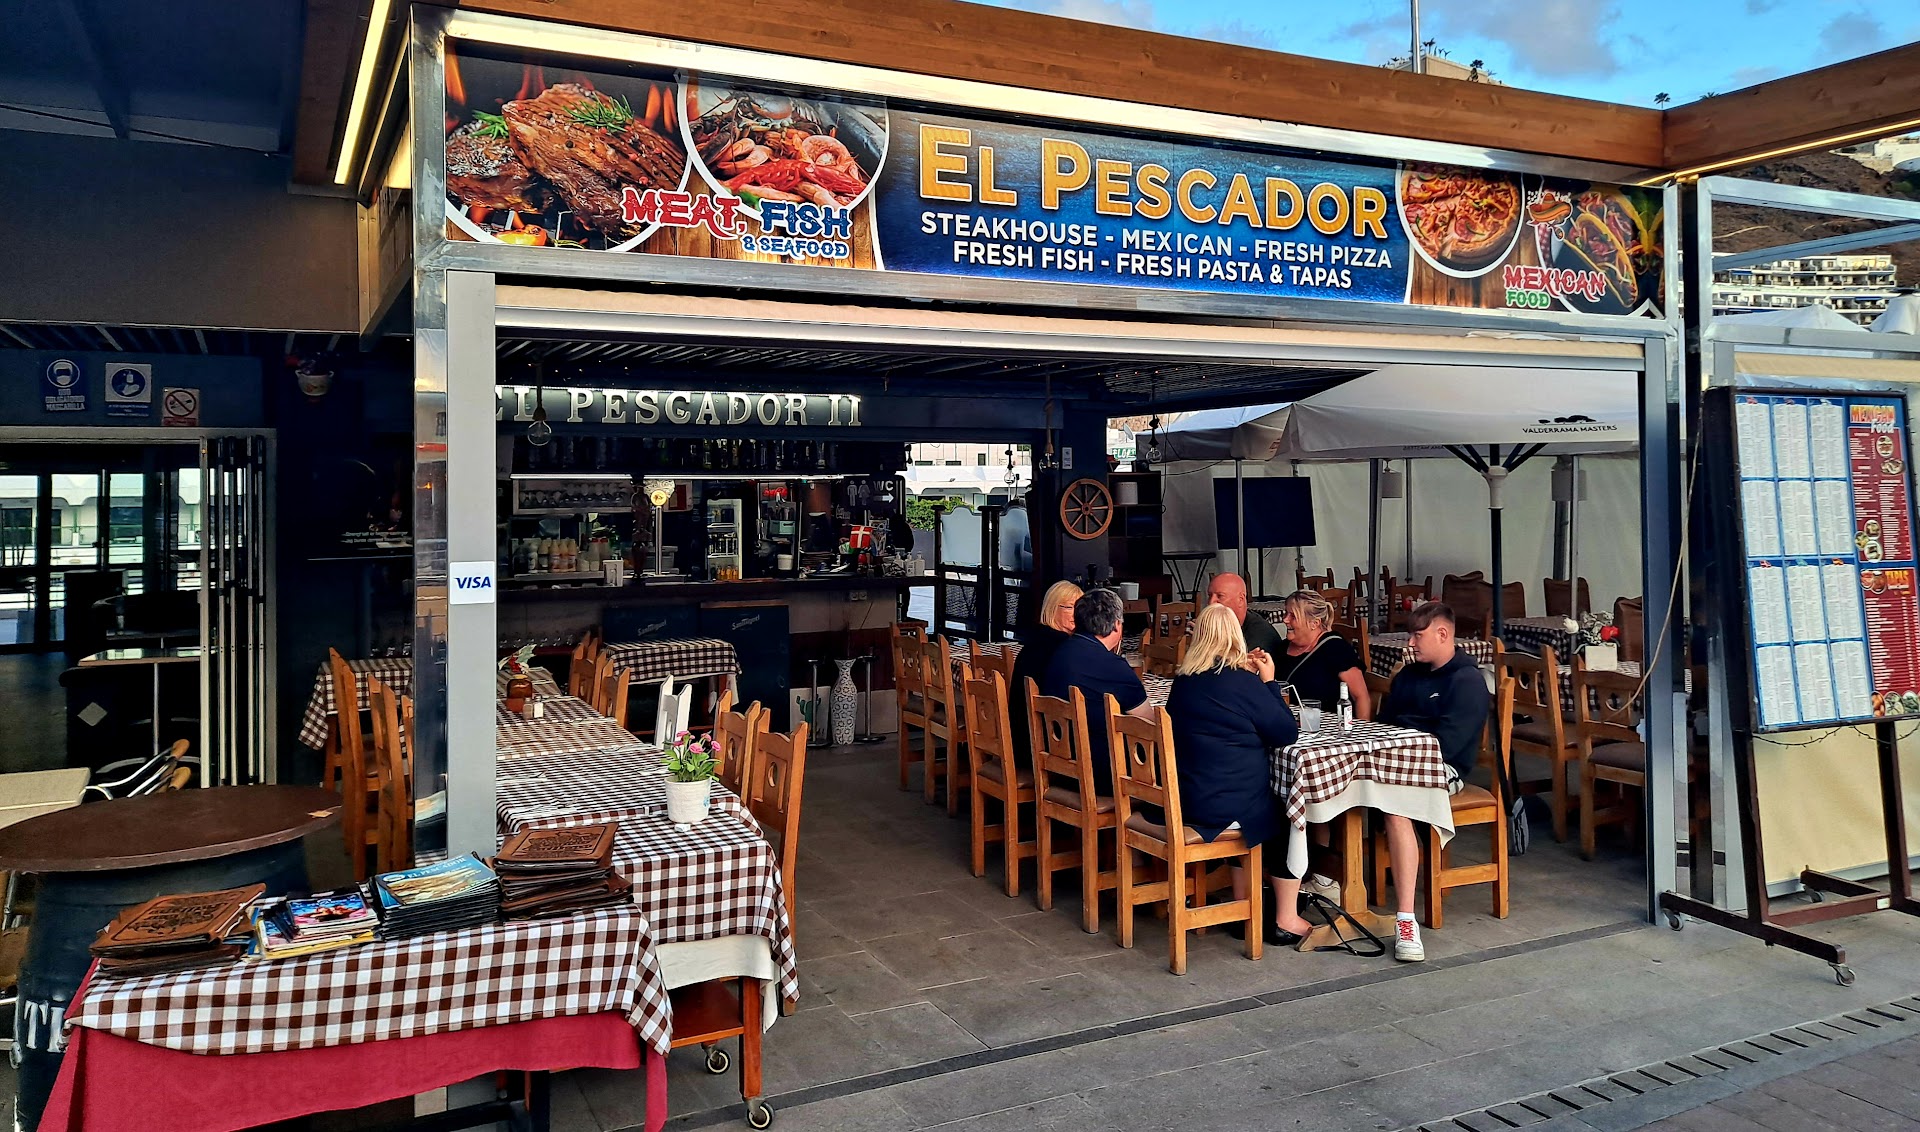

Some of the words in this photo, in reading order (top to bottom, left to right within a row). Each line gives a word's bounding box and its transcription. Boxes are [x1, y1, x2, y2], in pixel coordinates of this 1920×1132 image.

[920, 124, 1018, 207] EL
[1041, 137, 1389, 239] PESCADOR
[621, 188, 748, 240] MEAT,
[759, 200, 852, 239] FISH
[742, 236, 757, 252] &
[760, 236, 849, 259] SEAFOOD
[921, 211, 1098, 247] STEAKHOUSE
[1122, 228, 1232, 257] MEXICAN
[1254, 239, 1324, 264] FRESH
[1331, 245, 1392, 269] PIZZA
[953, 241, 1034, 268] FRESH
[1041, 247, 1094, 272] FISH
[1116, 252, 1191, 278] FRESH
[1198, 259, 1264, 283] PASTA
[1269, 264, 1283, 284] &
[1289, 265, 1352, 289] TAPAS
[1503, 265, 1605, 302] MEXICAN
[1506, 290, 1551, 308] FOOD
[566, 388, 808, 426] PESCADOR
[828, 394, 862, 426] II
[1580, 424, 1618, 432] MASTERS
[873, 480, 894, 491] WC
[453, 576, 492, 589] VISA
